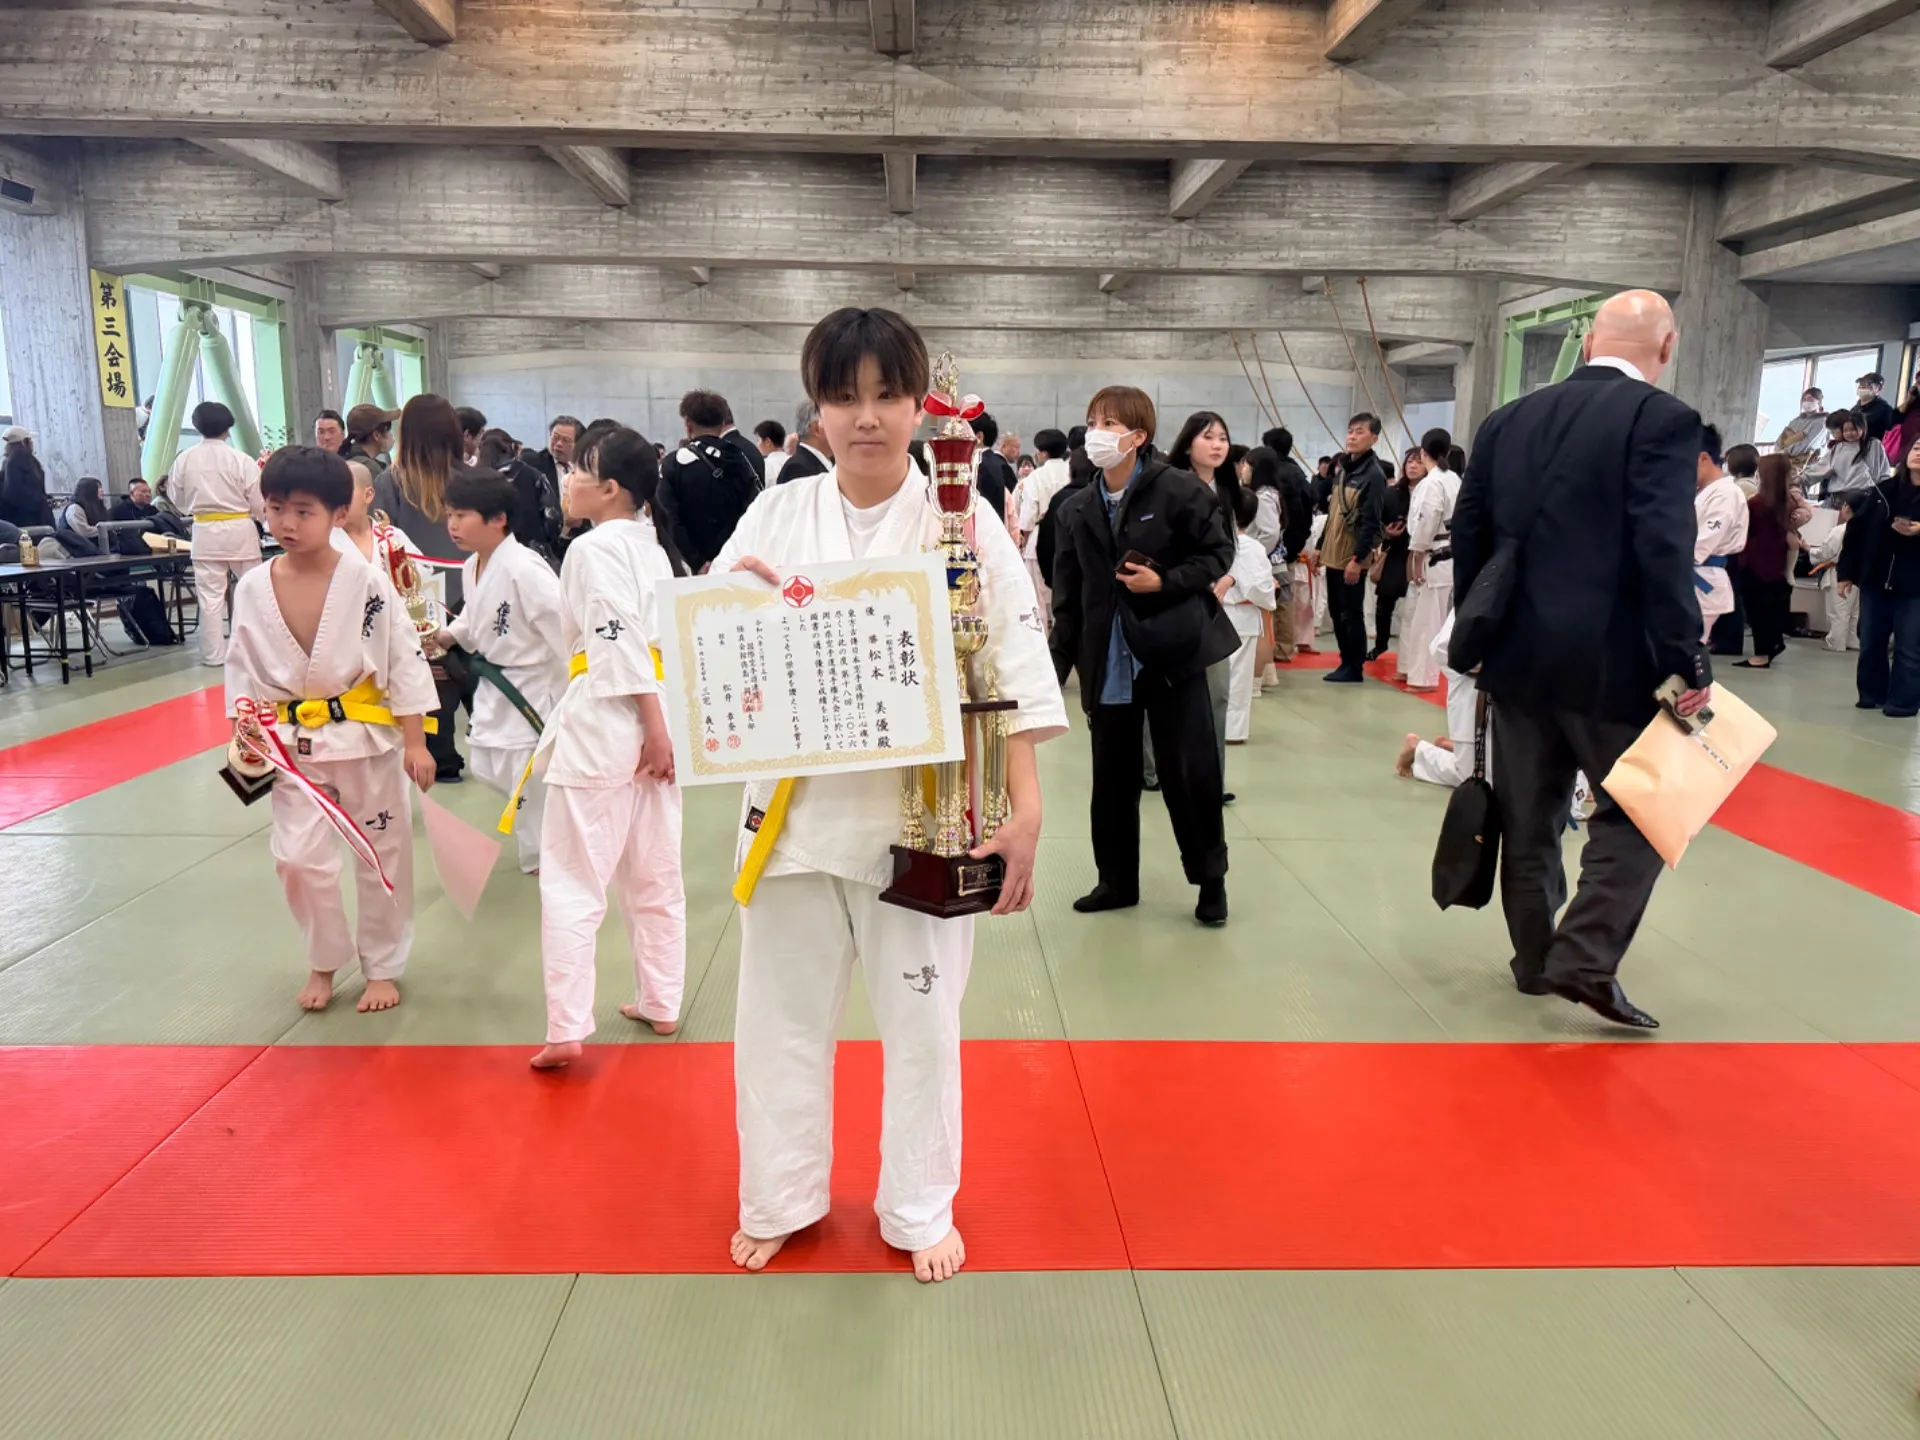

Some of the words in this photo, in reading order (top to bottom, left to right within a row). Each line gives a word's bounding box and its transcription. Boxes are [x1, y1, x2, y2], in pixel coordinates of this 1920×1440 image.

[99, 281, 127, 398] 第三会場
[595, 619, 625, 641] 一撃
[799, 614, 807, 631] した
[897, 629, 920, 687] 表彰状
[903, 964, 940, 995] 一撃
